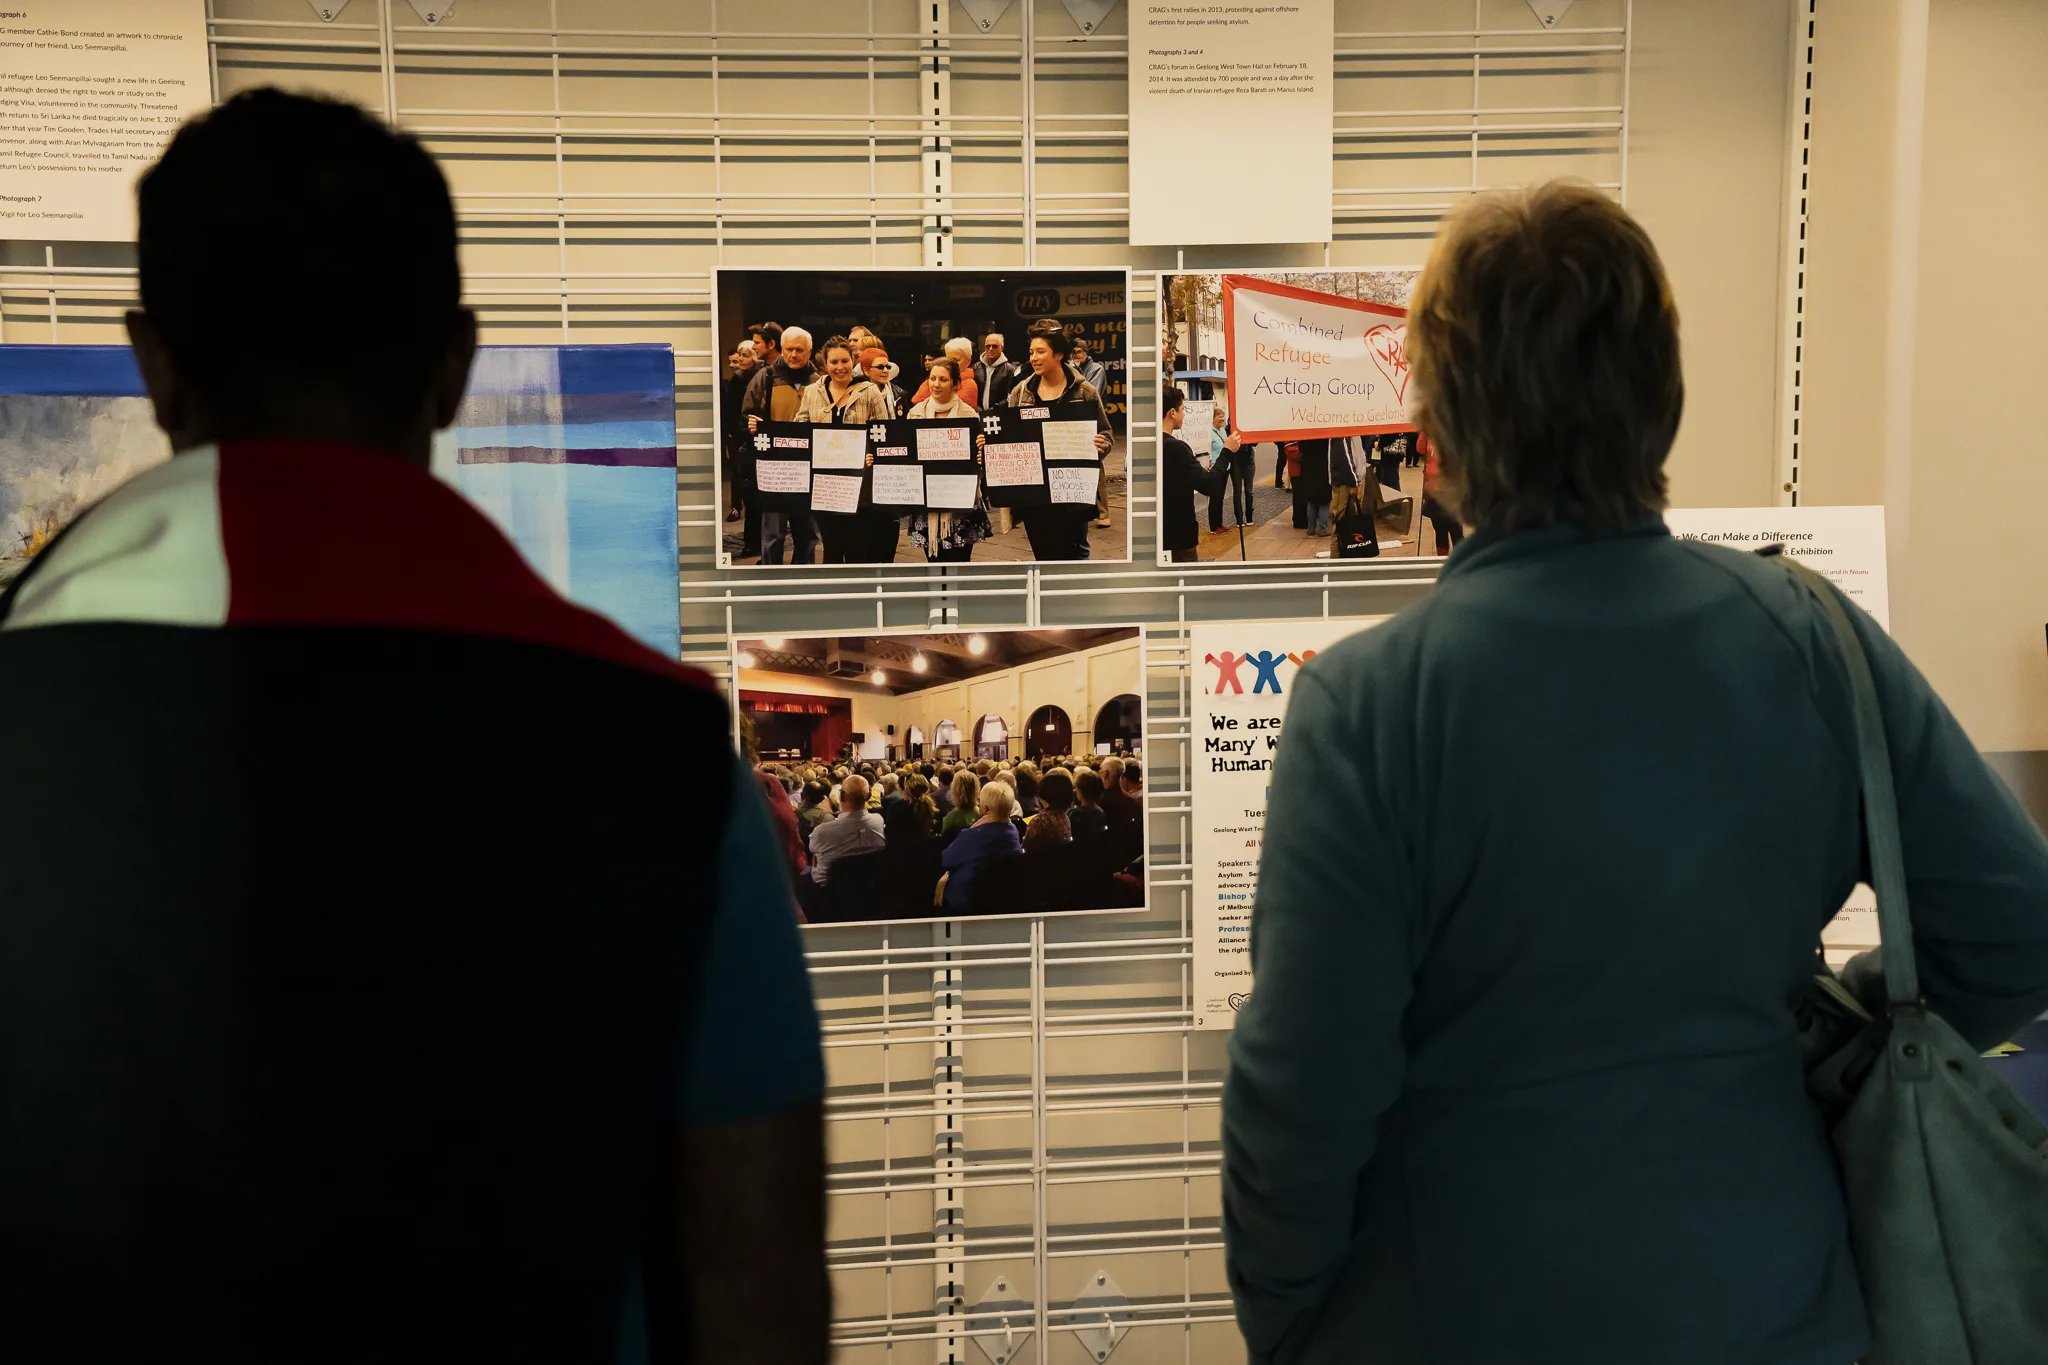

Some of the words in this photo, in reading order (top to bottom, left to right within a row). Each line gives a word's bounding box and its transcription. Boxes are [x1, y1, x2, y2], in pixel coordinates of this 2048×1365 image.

[1066, 291, 1124, 306] CHEMIS
[1254, 312, 1344, 341] Combined
[1255, 343, 1331, 370] Refugee
[1253, 376, 1321, 396] Action
[1328, 379, 1375, 400] Group
[1021, 408, 1049, 418] FACTS
[1291, 407, 1350, 424] Welcome
[1353, 410, 1364, 422] to
[1367, 407, 1405, 424] Geelong
[948, 429, 962, 440] NOT
[775, 439, 807, 448] FACTS
[877, 448, 907, 456] FACTS
[1052, 470, 1063, 479] NO
[1066, 469, 1081, 479] ONE
[1701, 533, 1720, 541] Can
[1722, 532, 1750, 541] Make
[1762, 531, 1813, 542] Difference
[1247, 717, 1281, 729] are
